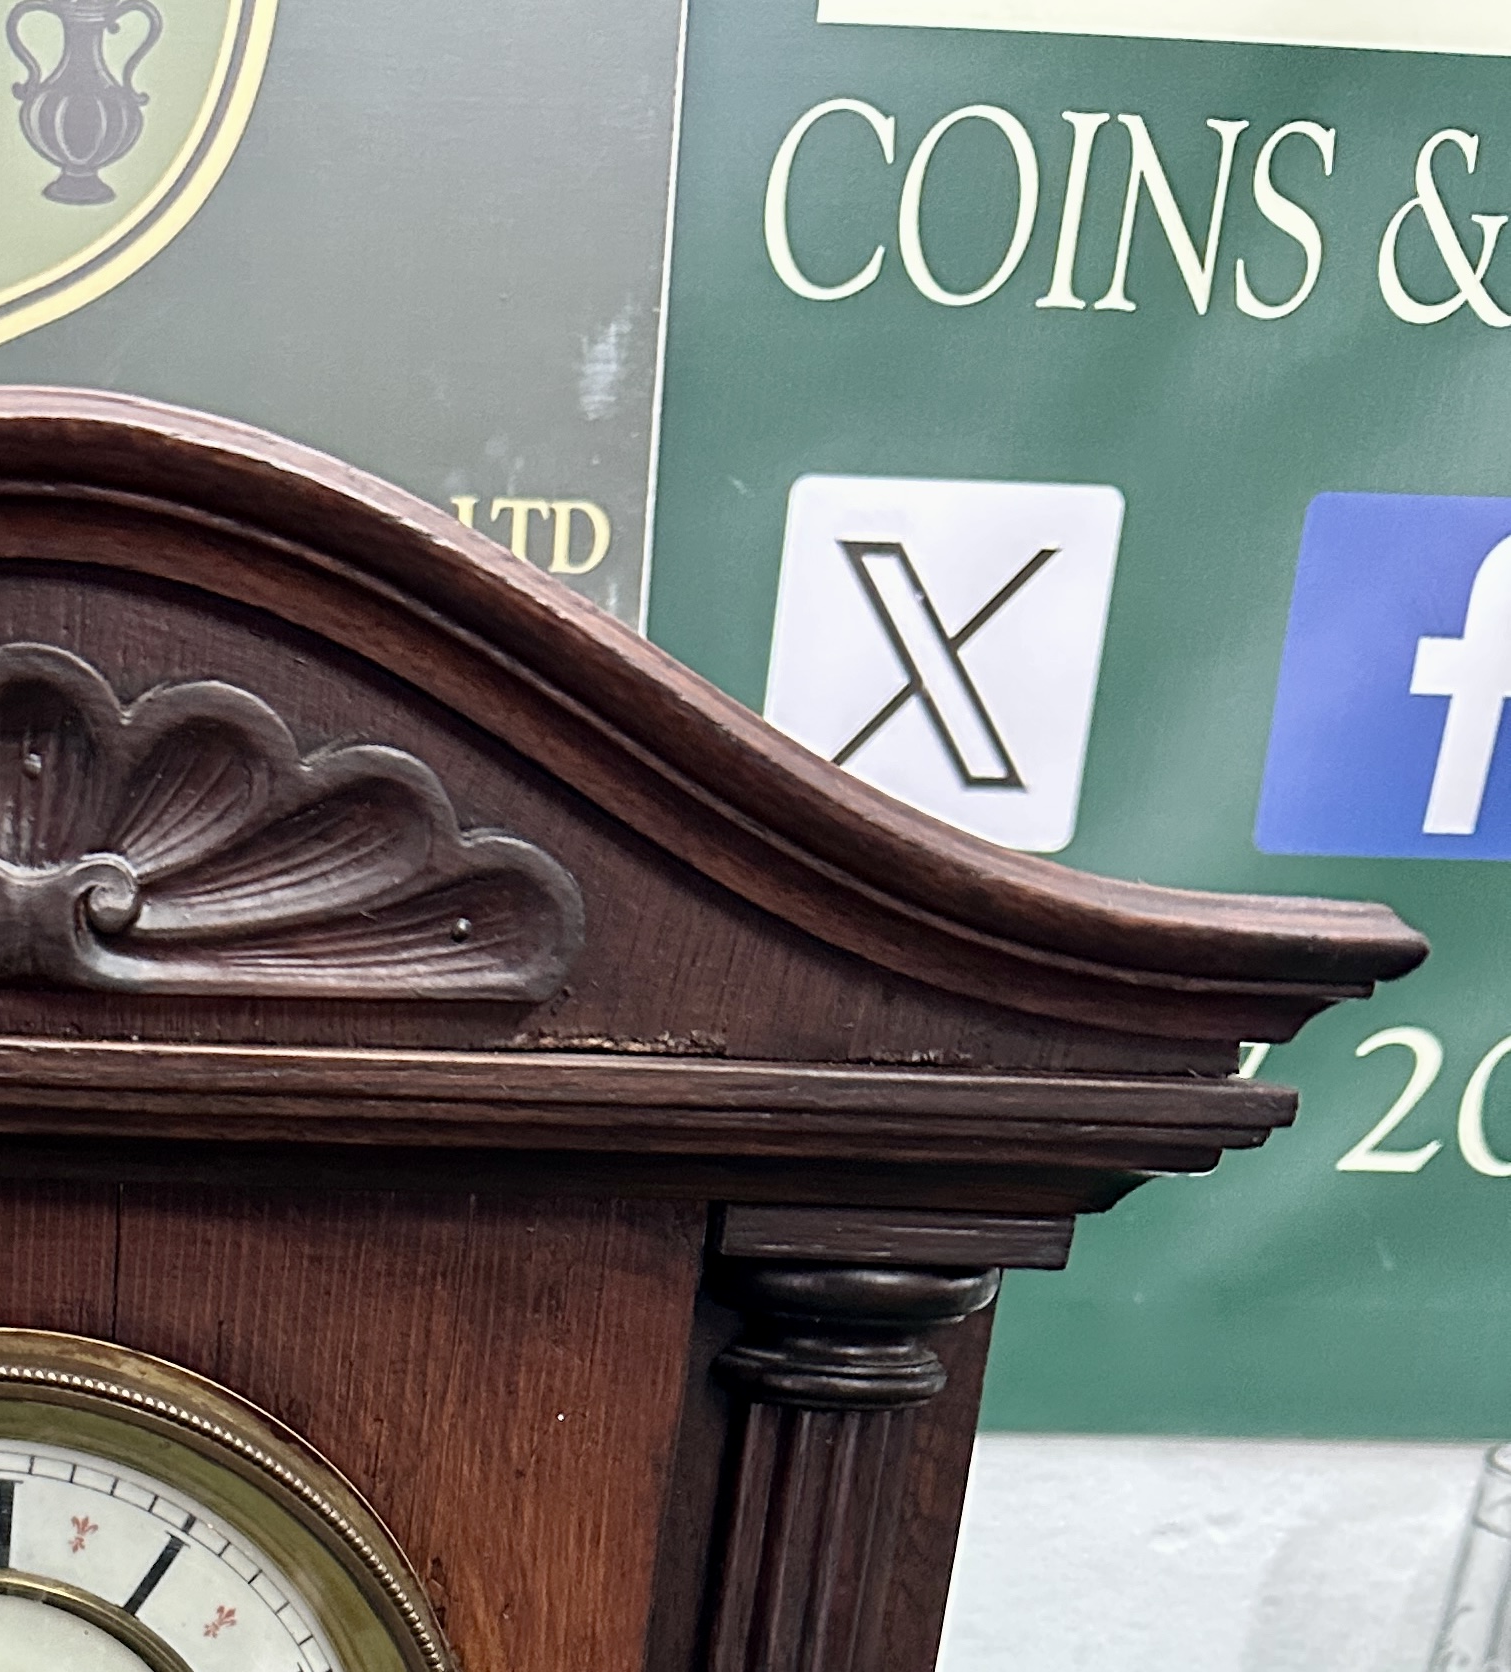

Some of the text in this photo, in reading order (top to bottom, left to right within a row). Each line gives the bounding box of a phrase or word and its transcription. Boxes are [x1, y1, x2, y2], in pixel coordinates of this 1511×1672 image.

[763, 97, 1511, 328] COINS &
[120, 1530, 191, 1618] I
